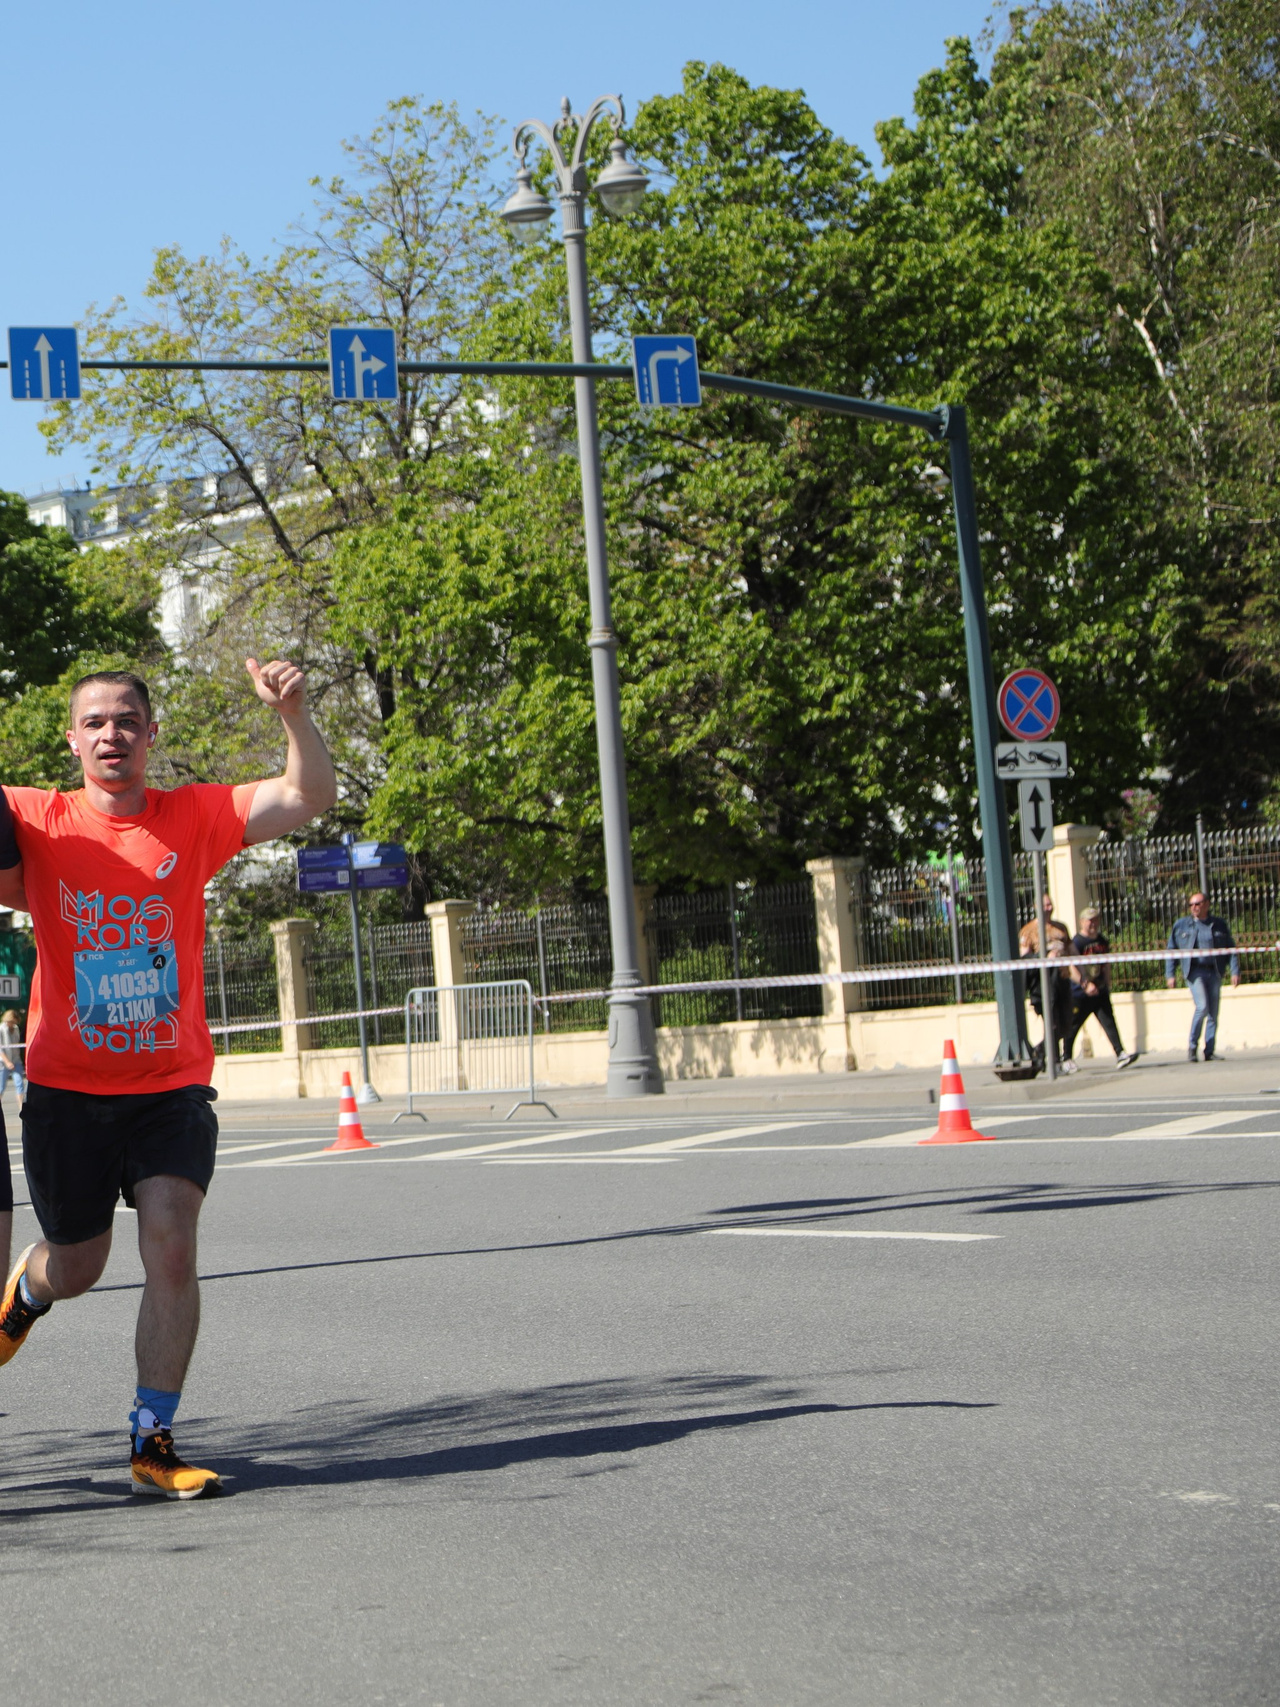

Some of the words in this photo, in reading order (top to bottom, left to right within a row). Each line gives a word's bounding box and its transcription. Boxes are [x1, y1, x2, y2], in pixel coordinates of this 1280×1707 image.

[98, 969, 160, 1000] 41033
[106, 997, 157, 1024] 21.1KM
[81, 1027, 155, 1054] ФОН
